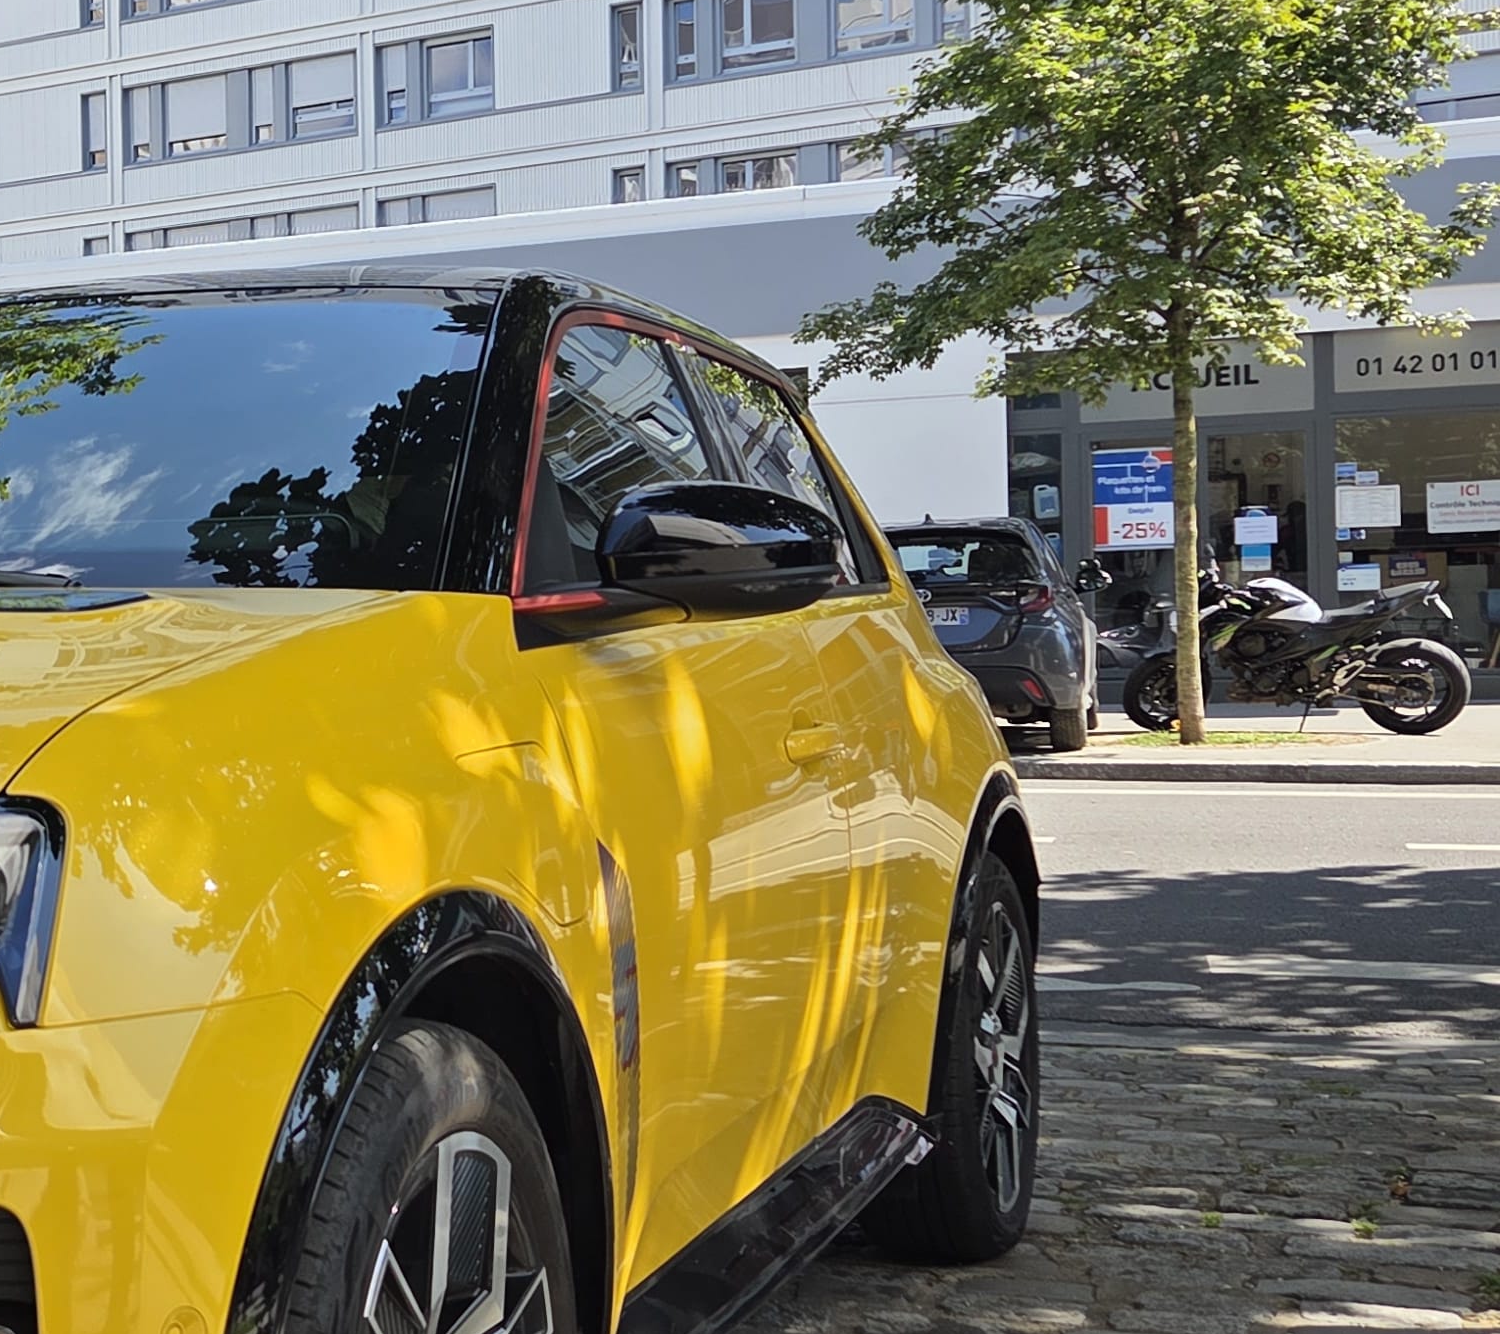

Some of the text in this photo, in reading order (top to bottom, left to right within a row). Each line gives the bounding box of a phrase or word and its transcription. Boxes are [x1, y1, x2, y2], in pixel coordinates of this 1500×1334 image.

[1356, 350, 1497, 377] 01 42 01 01
[1131, 364, 1260, 392] CUEIL
[1460, 484, 1480, 496] ICI
[1113, 521, 1167, 540] -25%
